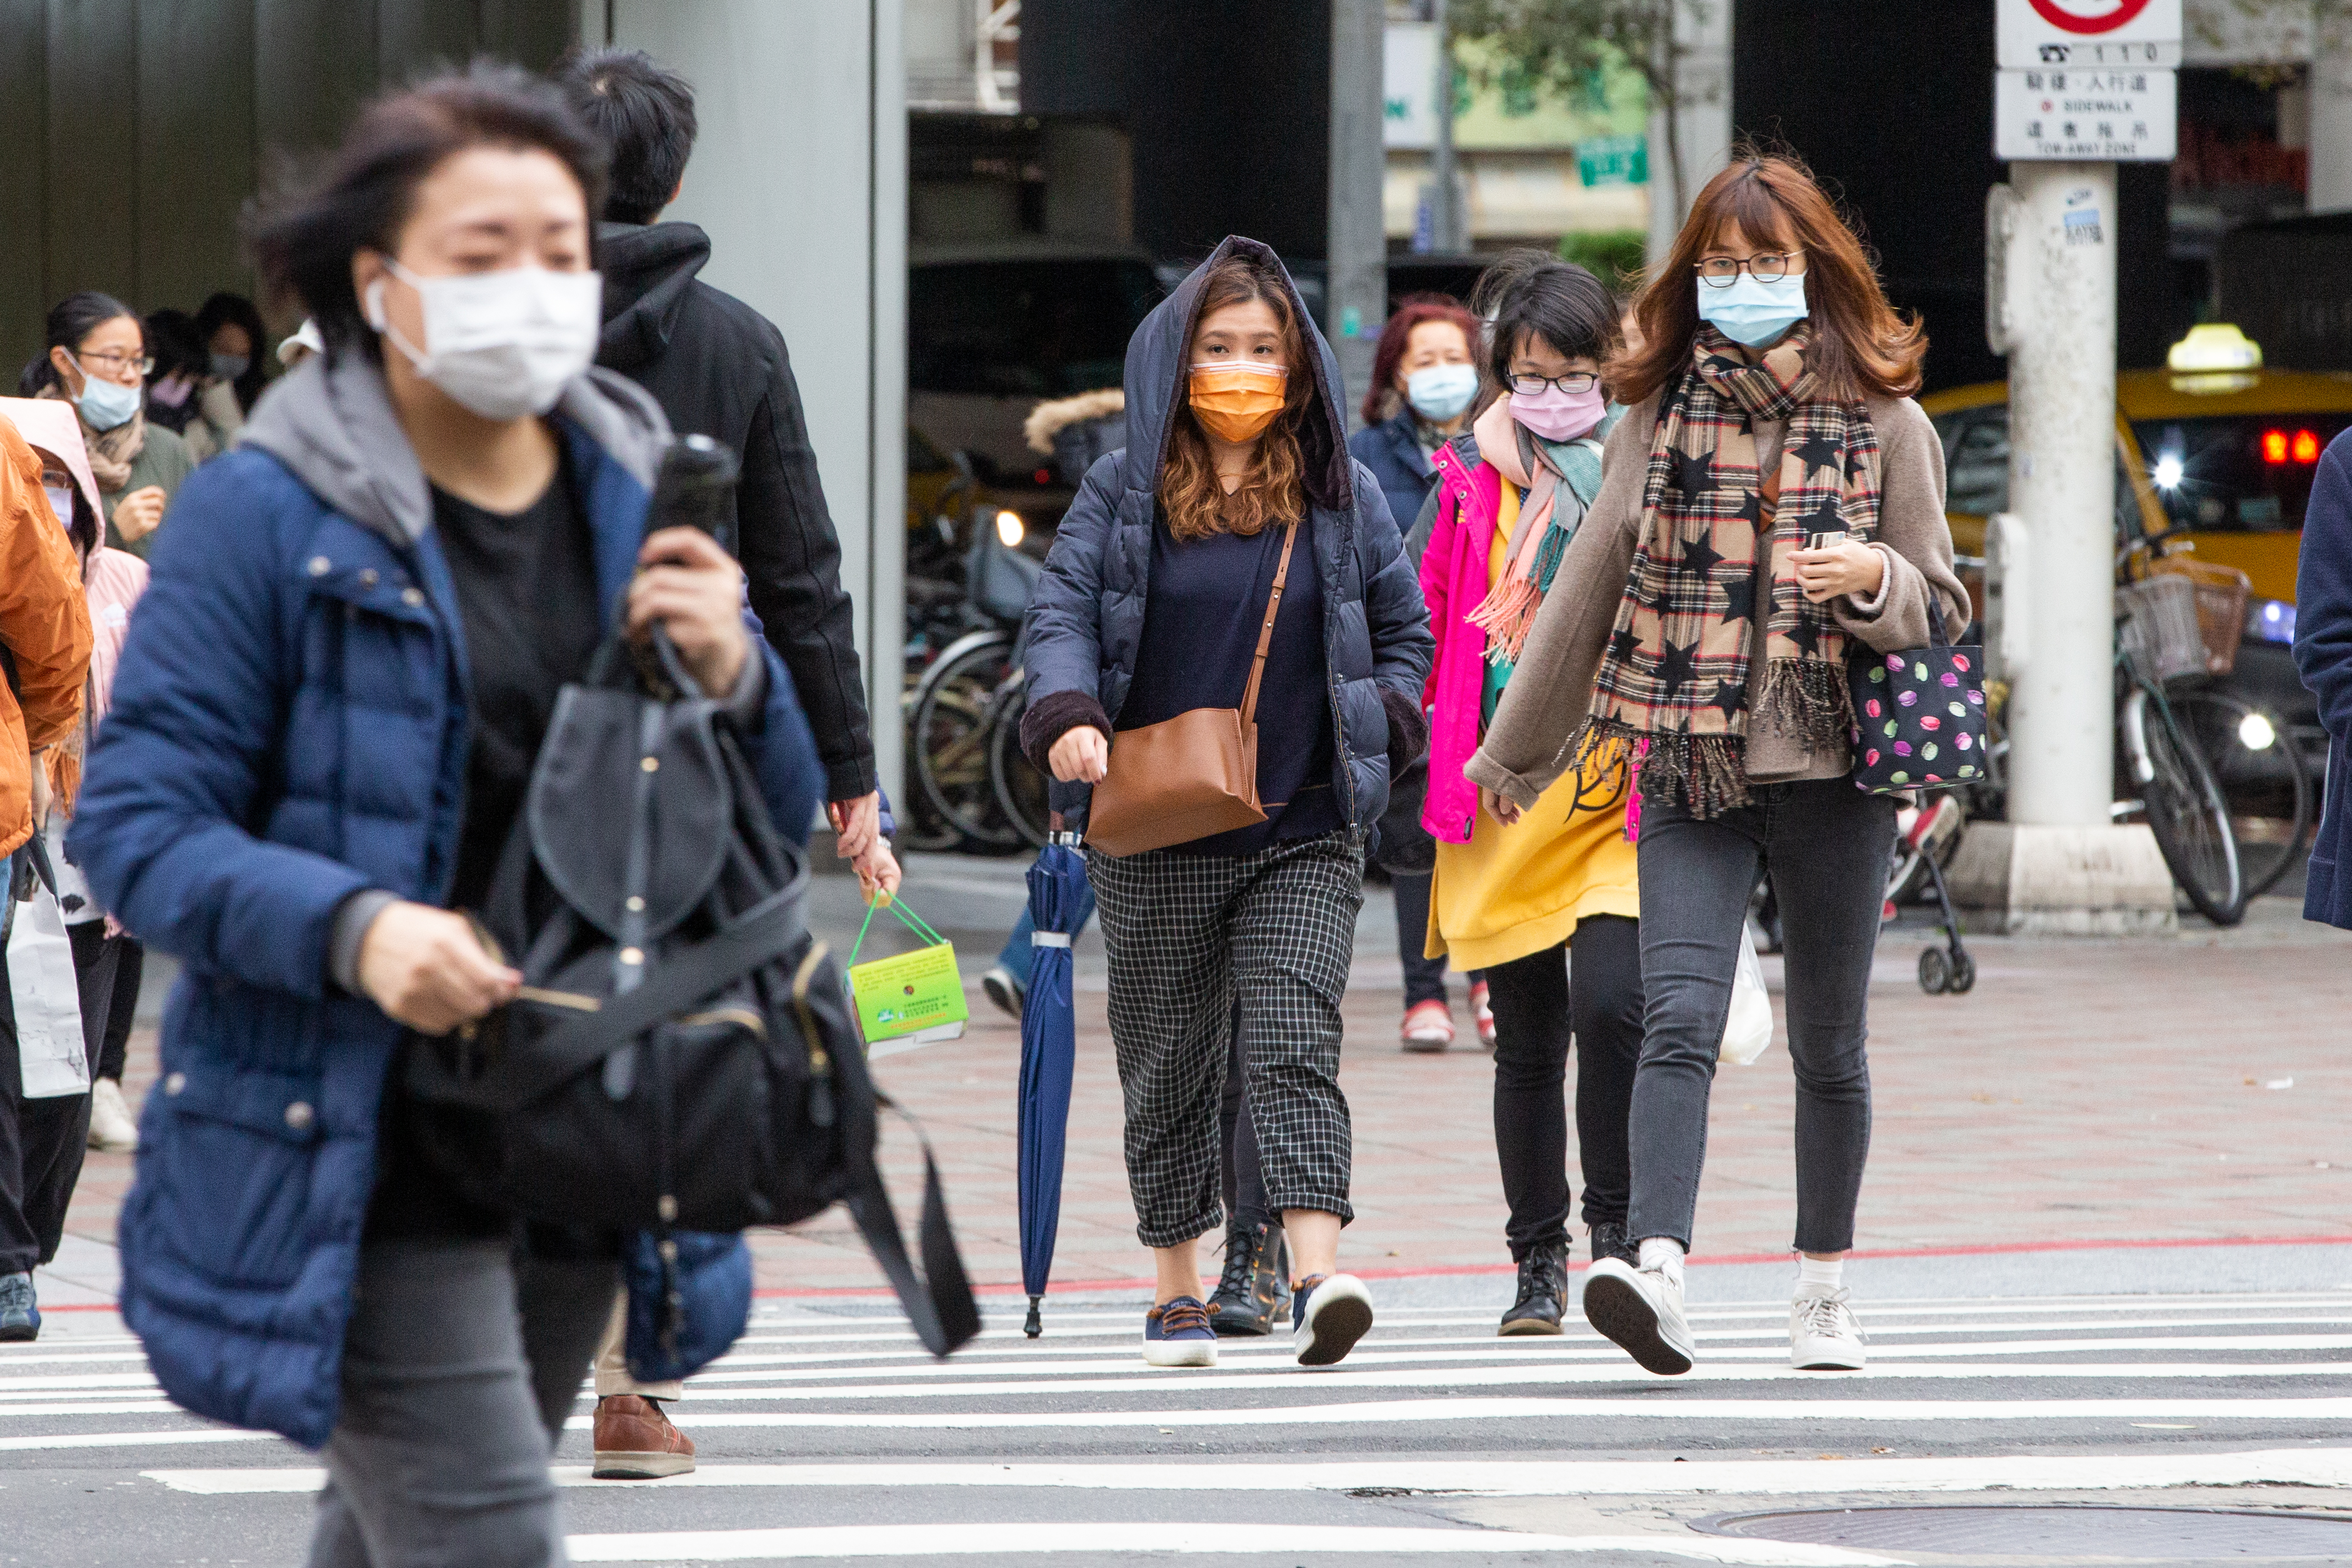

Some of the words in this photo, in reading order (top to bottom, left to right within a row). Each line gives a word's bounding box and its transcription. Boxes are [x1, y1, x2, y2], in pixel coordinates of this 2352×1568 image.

[2096, 43, 2157, 62] 110
[2064, 99, 2133, 112] SIDEWALK
[2105, 142, 2136, 155] ZONE
